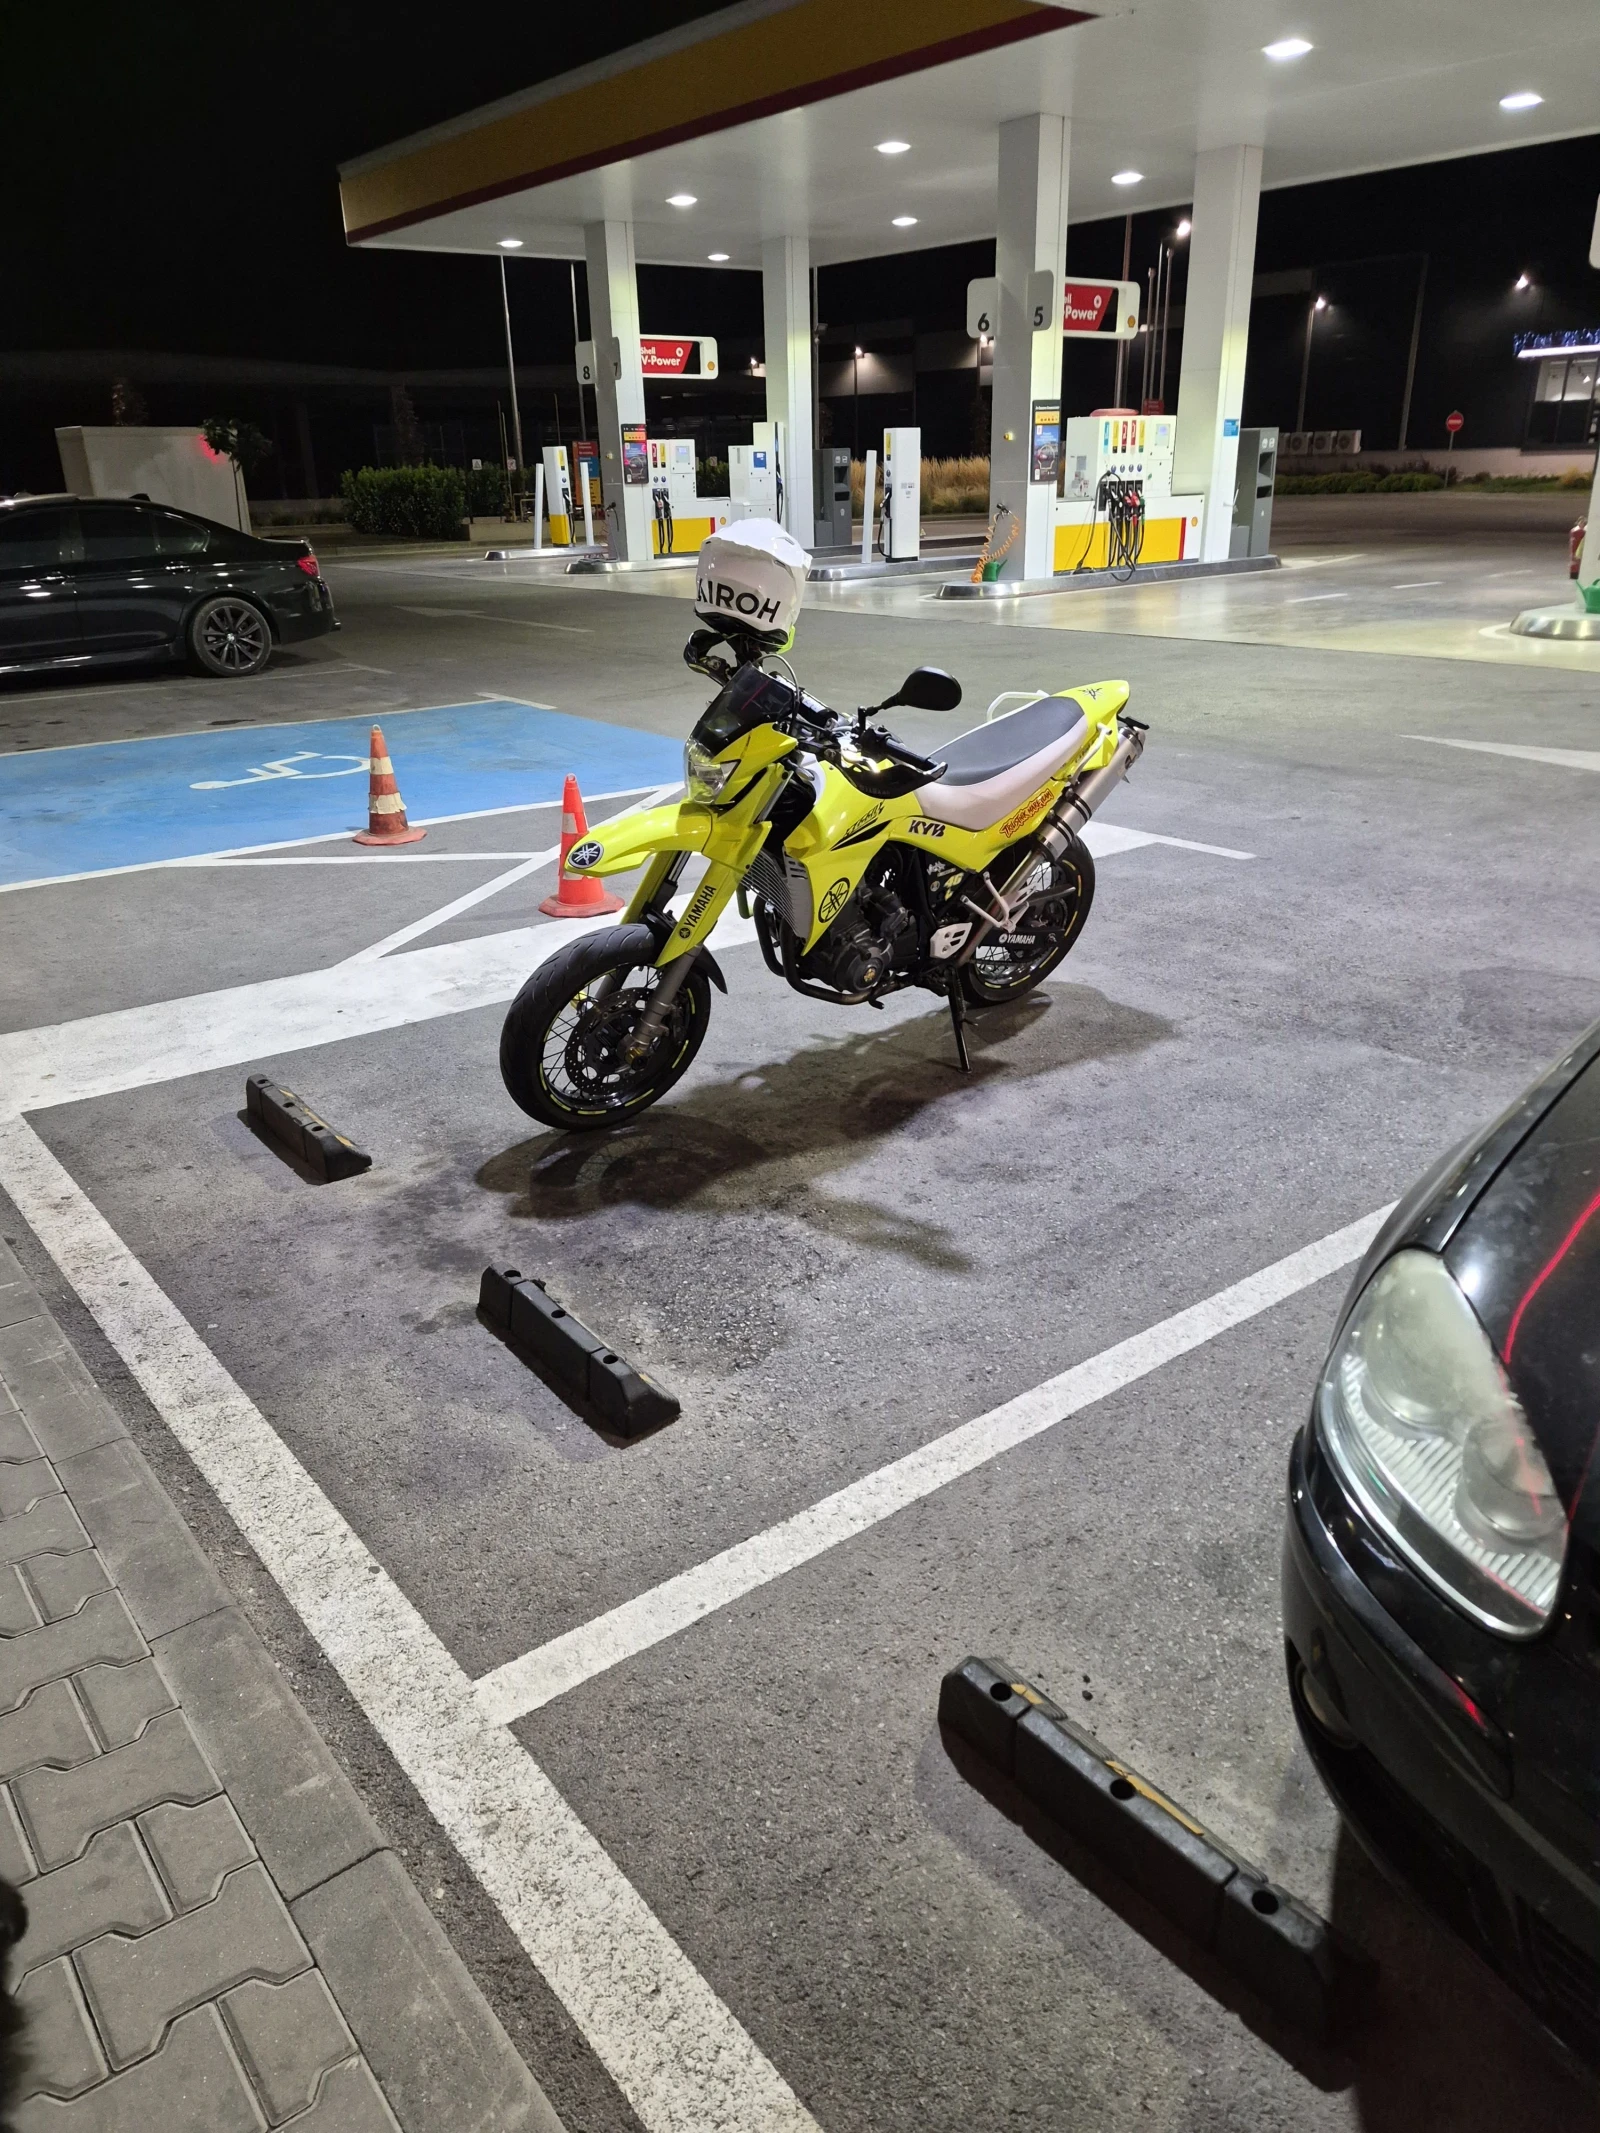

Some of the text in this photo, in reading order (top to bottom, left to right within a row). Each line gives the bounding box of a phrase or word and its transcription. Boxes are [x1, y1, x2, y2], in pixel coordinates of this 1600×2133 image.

[977, 312, 990, 332] 6
[1033, 306, 1044, 327] 5
[641, 355, 681, 366] V-Power
[582, 365, 591, 380] 8
[908, 819, 946, 838] KYB
[684, 885, 716, 927] YAMAHA
[1006, 934, 1036, 945] YAMAHA
